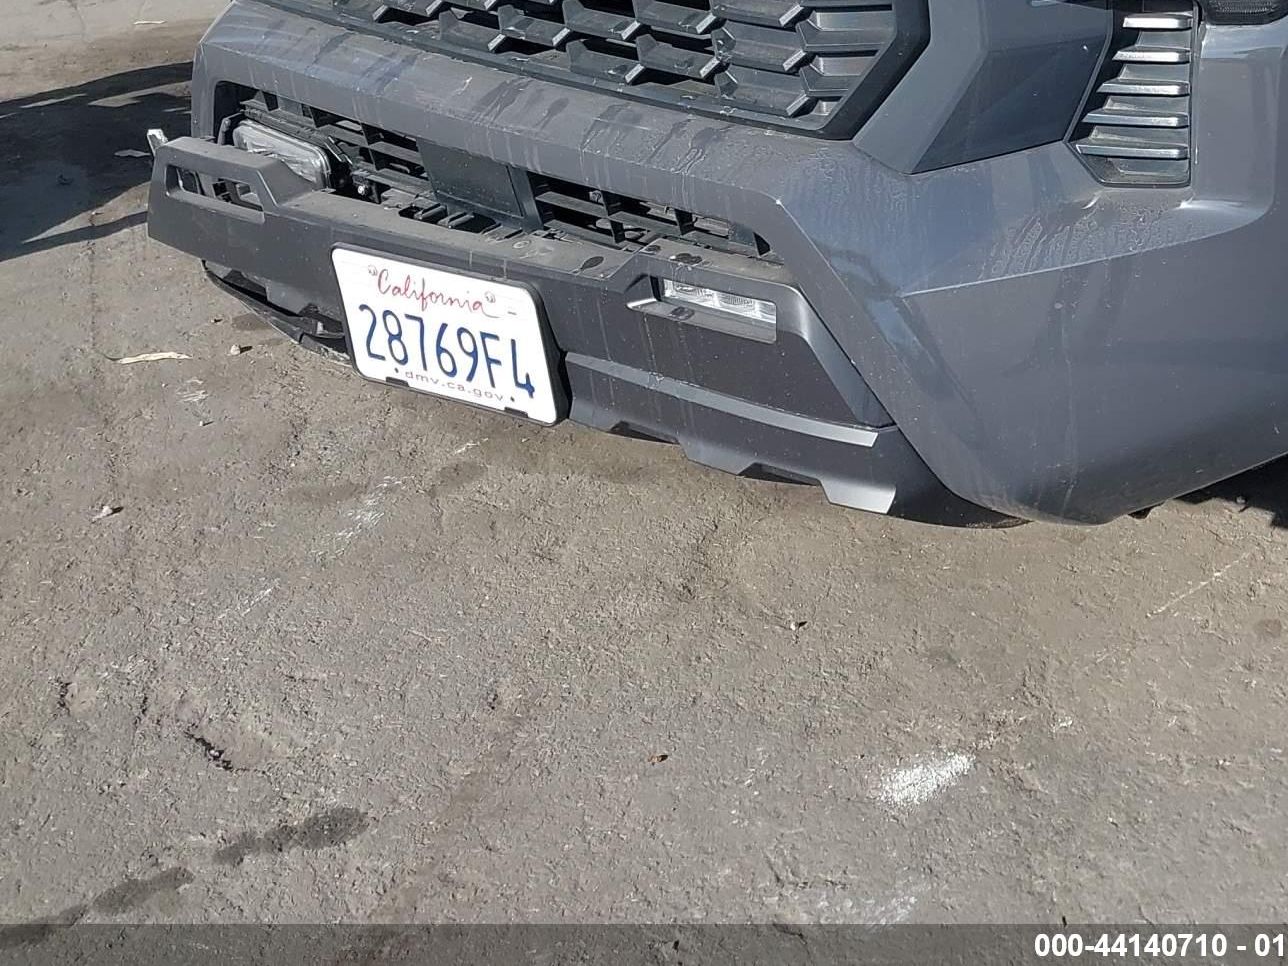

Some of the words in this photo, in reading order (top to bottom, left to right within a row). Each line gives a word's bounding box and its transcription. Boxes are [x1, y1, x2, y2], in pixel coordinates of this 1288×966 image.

[377, 268, 501, 318] California
[358, 303, 536, 399] 28769F4
[405, 370, 504, 401] dmv.ca.gov
